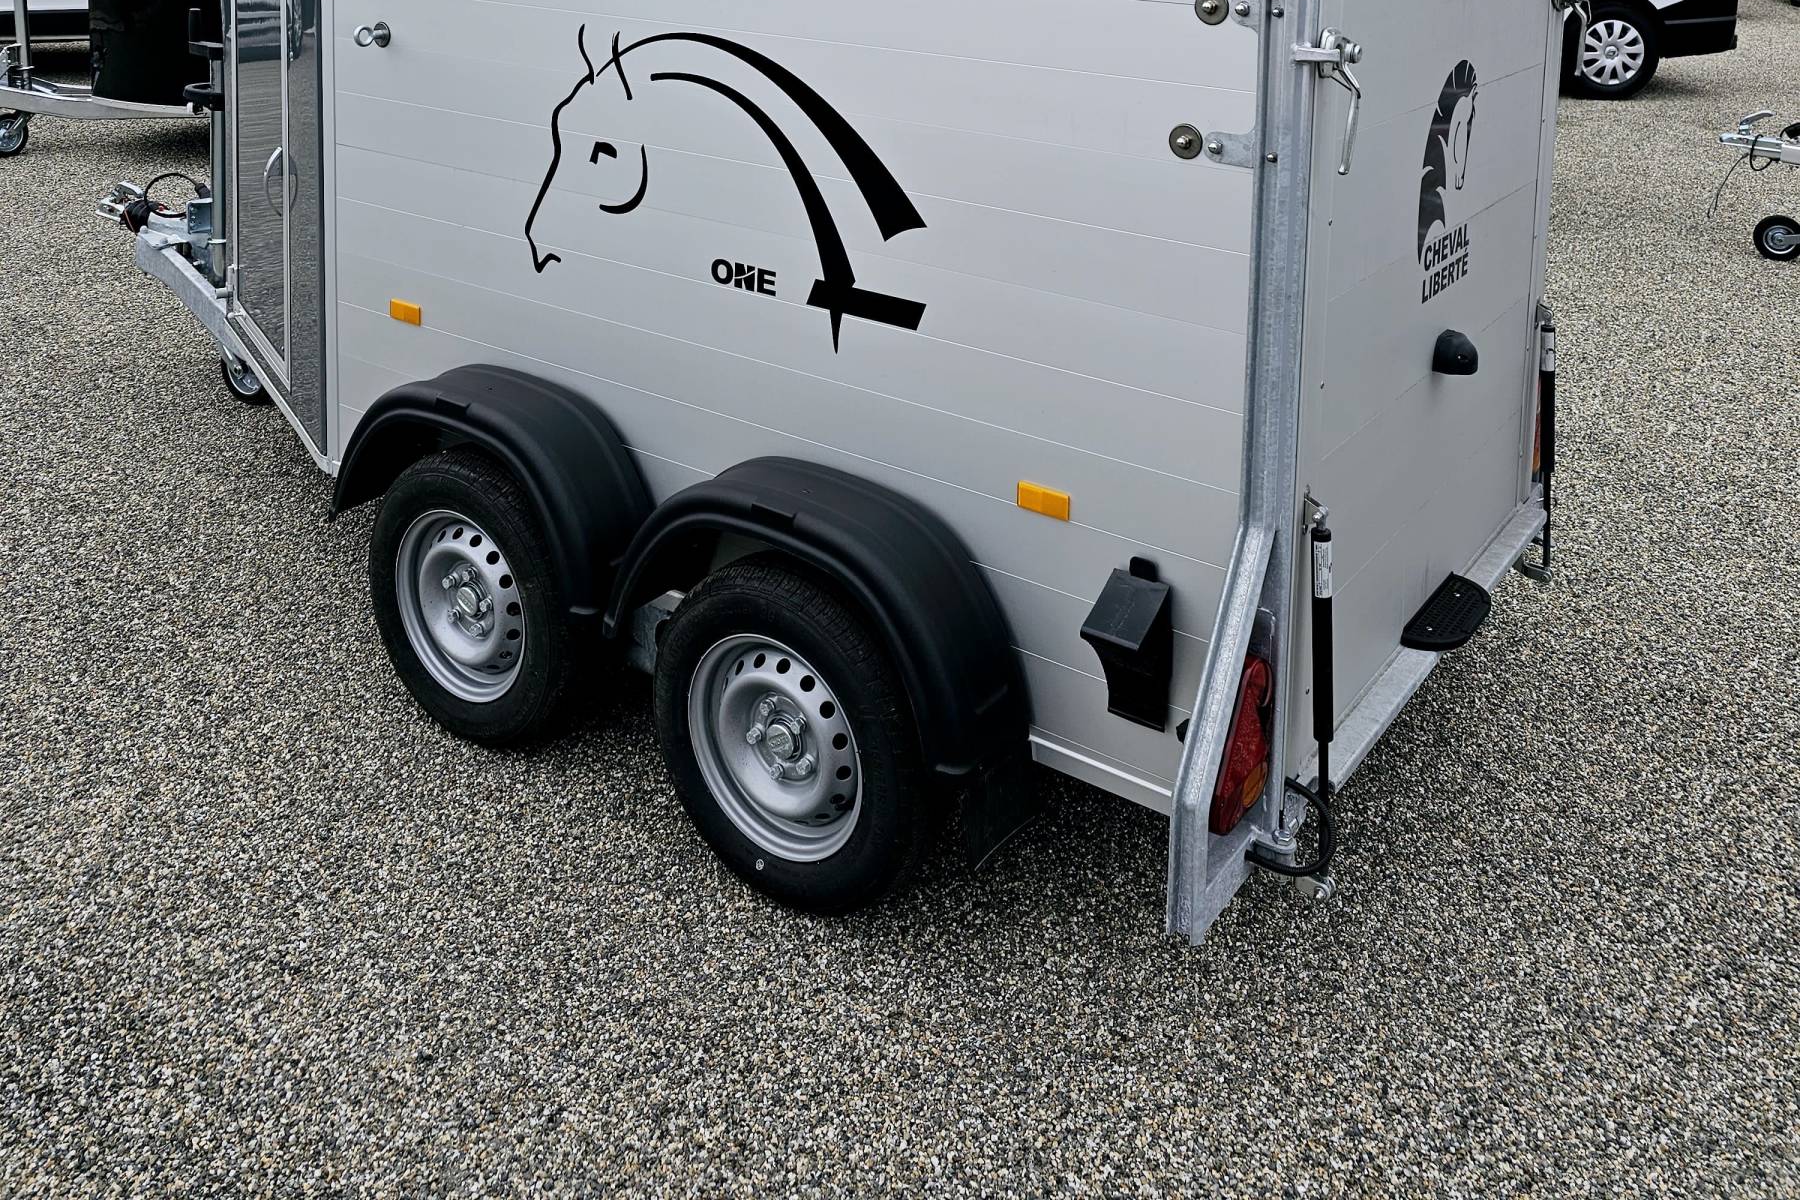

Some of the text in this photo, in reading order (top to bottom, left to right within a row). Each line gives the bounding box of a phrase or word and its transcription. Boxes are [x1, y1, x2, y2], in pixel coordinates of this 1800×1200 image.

[1423, 223, 1470, 272] CHEVAL
[711, 258, 777, 297] ONE
[1421, 247, 1469, 304] LIBERTÉ
